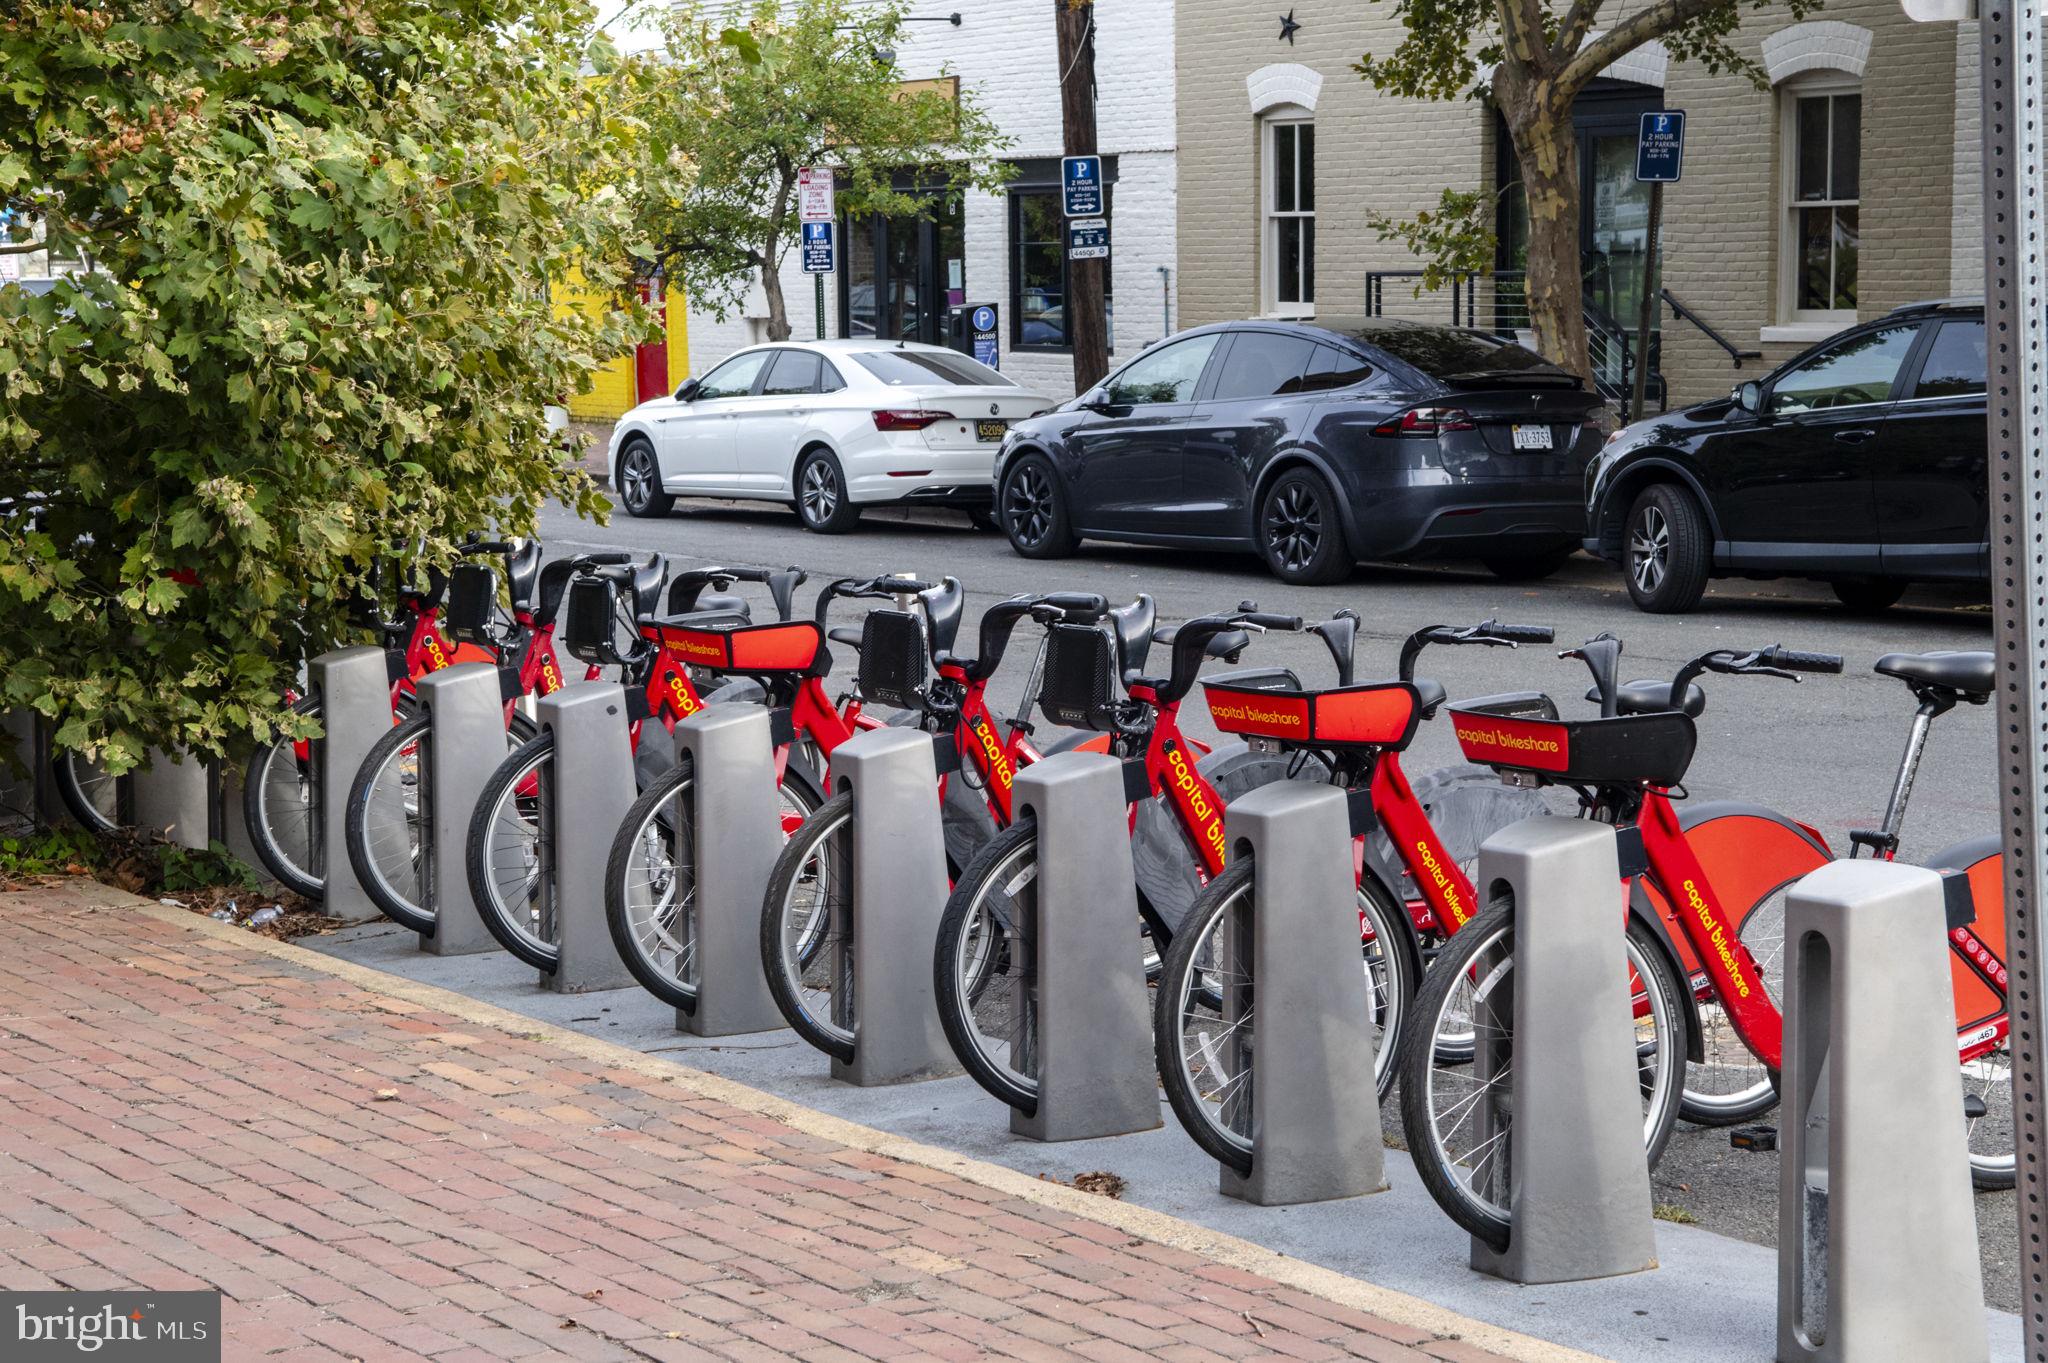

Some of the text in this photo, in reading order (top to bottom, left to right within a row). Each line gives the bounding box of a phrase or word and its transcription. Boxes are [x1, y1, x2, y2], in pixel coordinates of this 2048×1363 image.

[1657, 116, 1668, 132] P
[1648, 133, 1674, 141] 2 HOUR
[800, 172, 832, 181] NO PARKING
[1076, 162, 1088, 178] P
[803, 183, 829, 191] LOADING
[813, 223, 824, 238] P
[979, 311, 990, 327] P
[665, 639, 721, 656] capital bikeshare
[671, 677, 700, 716] capi
[1211, 705, 1301, 725] capital bikeshare
[1457, 728, 1559, 753] capital bikeshare
[1168, 749, 1212, 822] capital
[1417, 841, 1450, 889] capital
[1683, 879, 1750, 998] capital bikeshare
